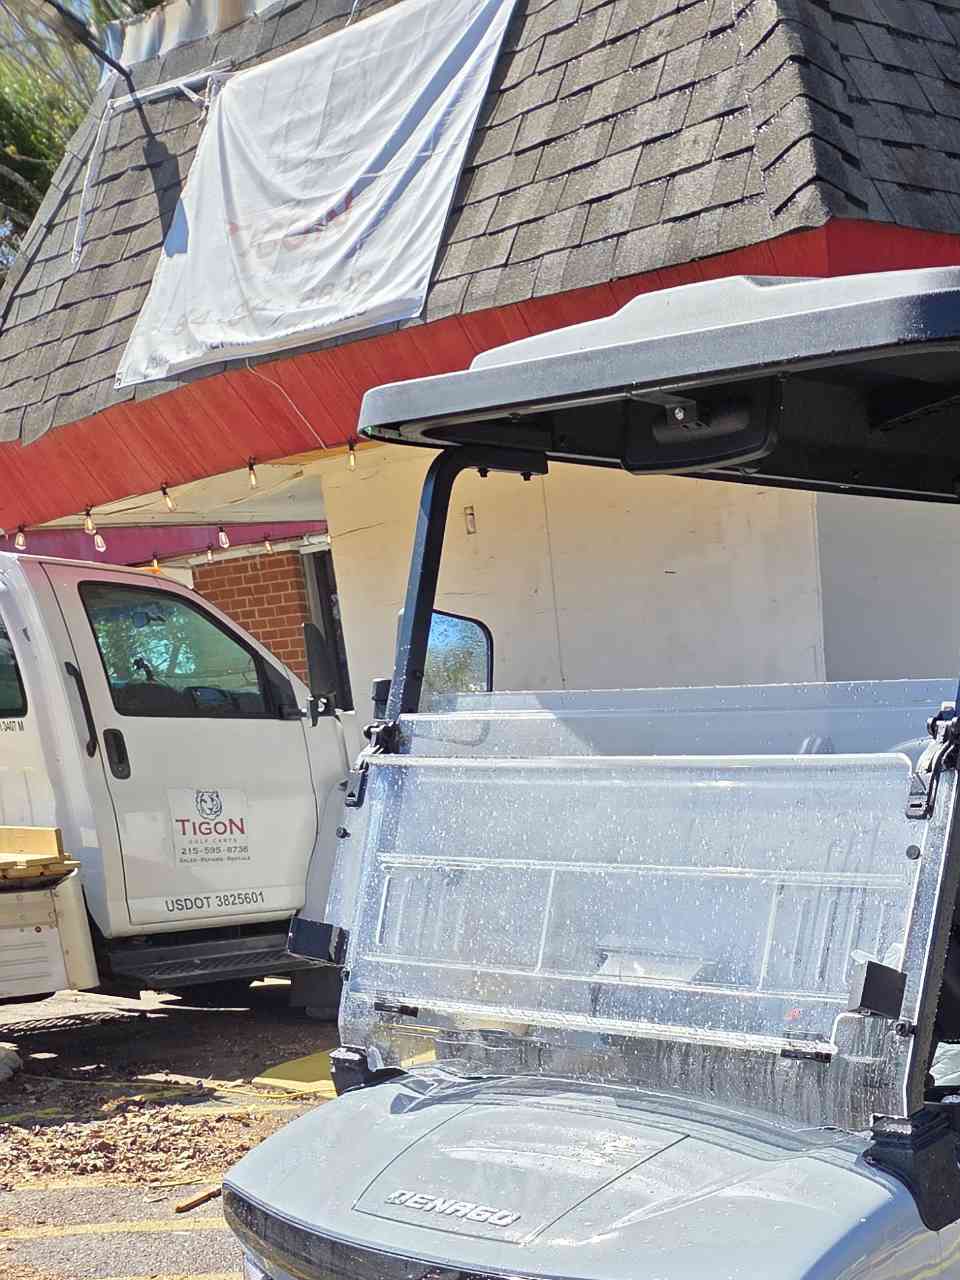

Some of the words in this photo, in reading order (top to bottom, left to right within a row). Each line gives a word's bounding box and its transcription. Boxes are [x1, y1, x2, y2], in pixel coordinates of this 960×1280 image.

[175, 817, 245, 836] TIGON
[165, 896, 212, 912] USDOT
[215, 891, 265, 907] 3825601
[384, 1190, 521, 1227] DENAGO
